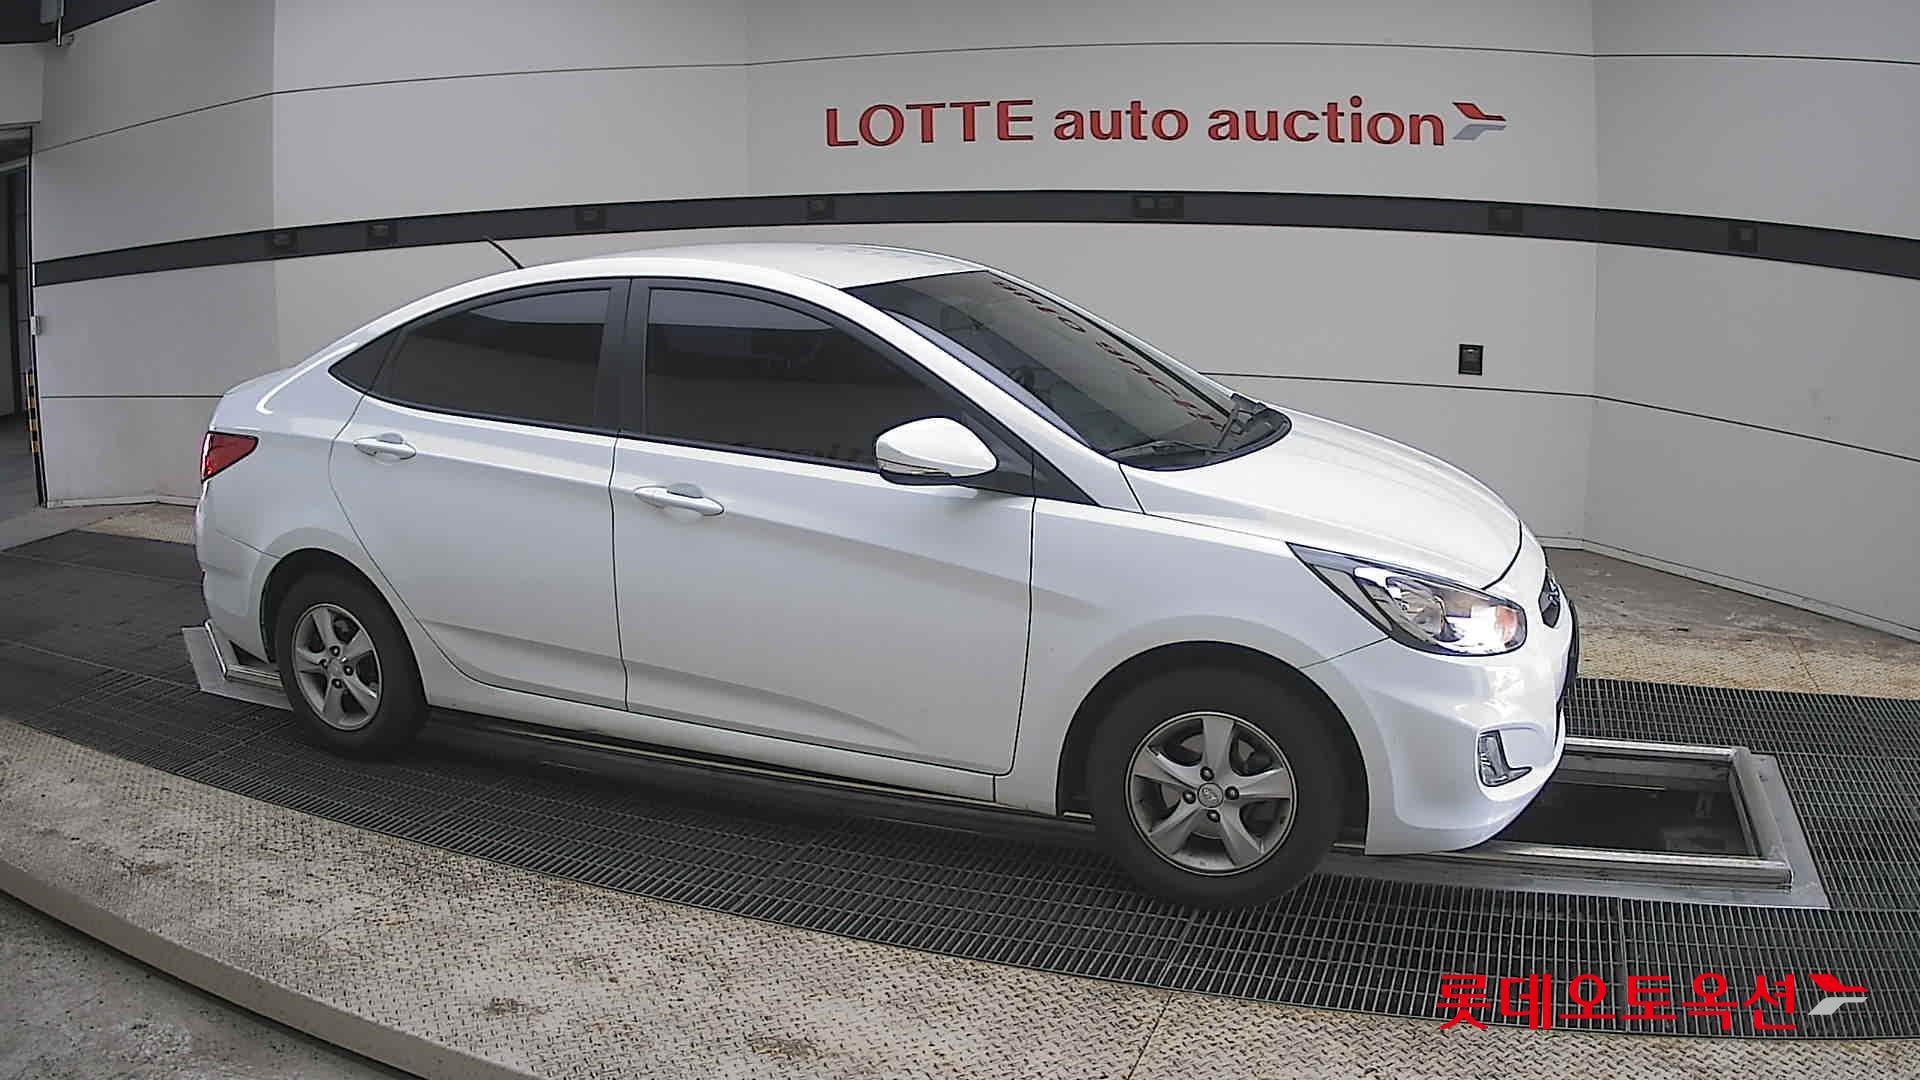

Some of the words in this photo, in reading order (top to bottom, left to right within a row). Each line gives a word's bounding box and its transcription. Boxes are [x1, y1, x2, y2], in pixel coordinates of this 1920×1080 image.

[826, 100, 1034, 147] LOTTE
[1054, 102, 1189, 140] auto
[1208, 96, 1444, 146] auction
